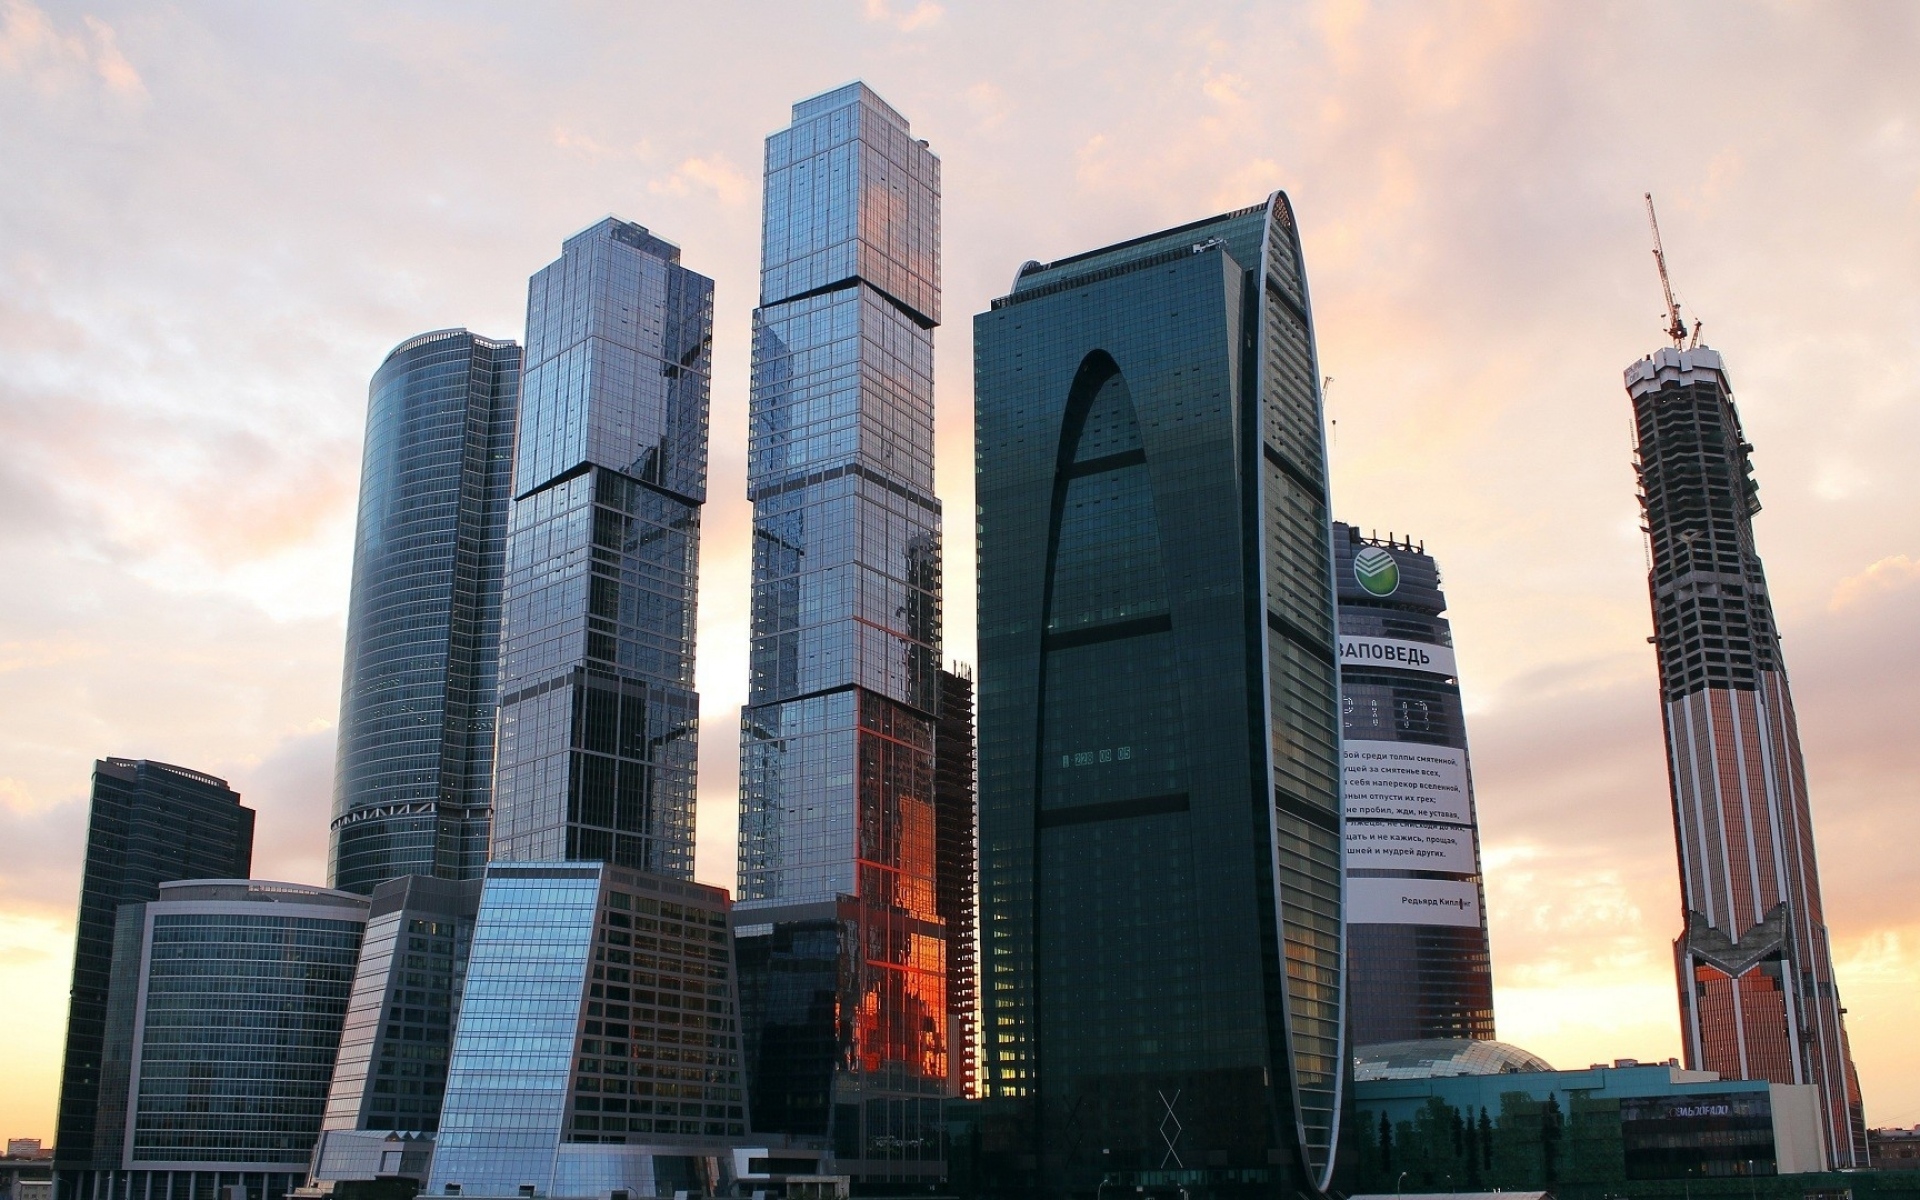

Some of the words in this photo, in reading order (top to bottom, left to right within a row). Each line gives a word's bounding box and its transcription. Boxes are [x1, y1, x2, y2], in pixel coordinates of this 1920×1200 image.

[1361, 752, 1388, 760] среди
[1416, 755, 1458, 766] смятенной,
[1380, 767, 1420, 775] смятенье
[1421, 769, 1441, 778] всех,
[1349, 778, 1371, 786] себя
[1372, 780, 1418, 789] наперекор
[1419, 783, 1461, 793] вселенной,
[1359, 806, 1394, 815] пробил,
[1429, 811, 1460, 819] уставая,
[1390, 834, 1424, 843] кажись,
[1426, 836, 1458, 845] прощая,
[1347, 846, 1372, 854] шней
[1382, 847, 1414, 856] мудрей
[1416, 849, 1446, 857] других.
[1401, 896, 1438, 906] Редьярд
[1439, 898, 1471, 907] Киплнг
